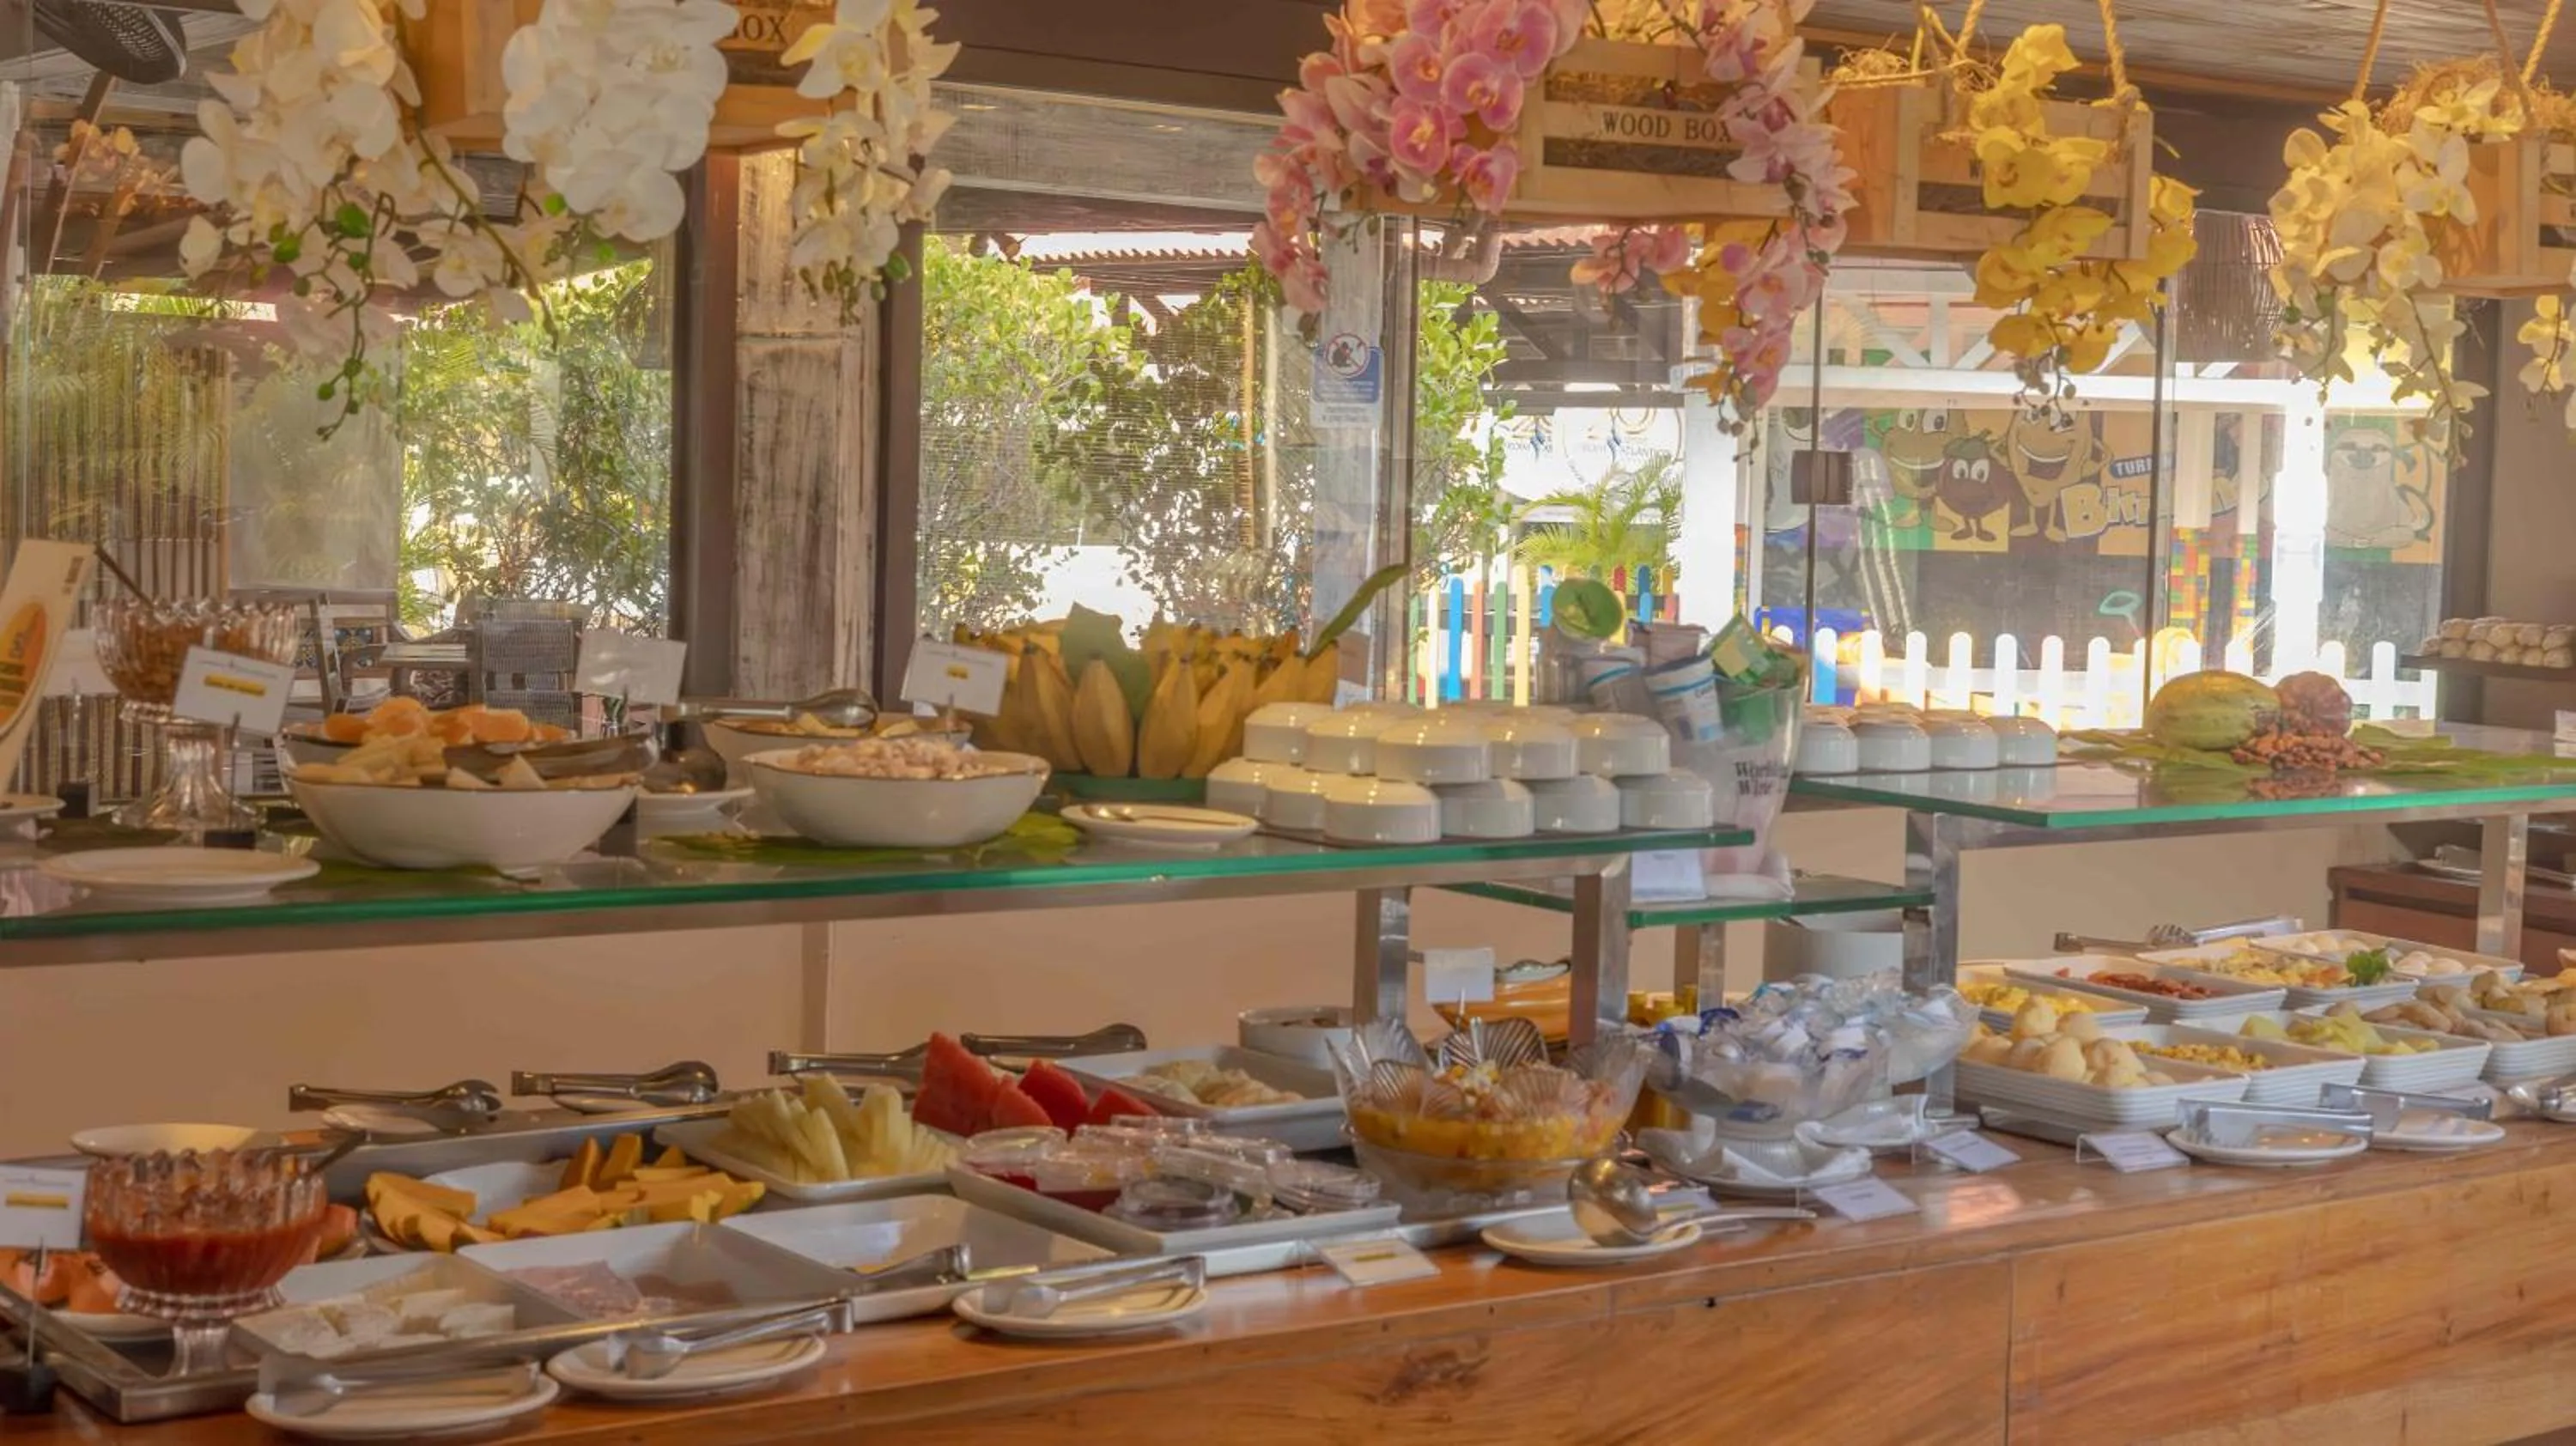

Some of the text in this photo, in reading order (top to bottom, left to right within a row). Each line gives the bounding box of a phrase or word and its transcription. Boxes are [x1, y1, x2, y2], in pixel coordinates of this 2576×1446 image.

[725, 14, 787, 43] OX
[1602, 112, 1732, 143] WOOD BOX
